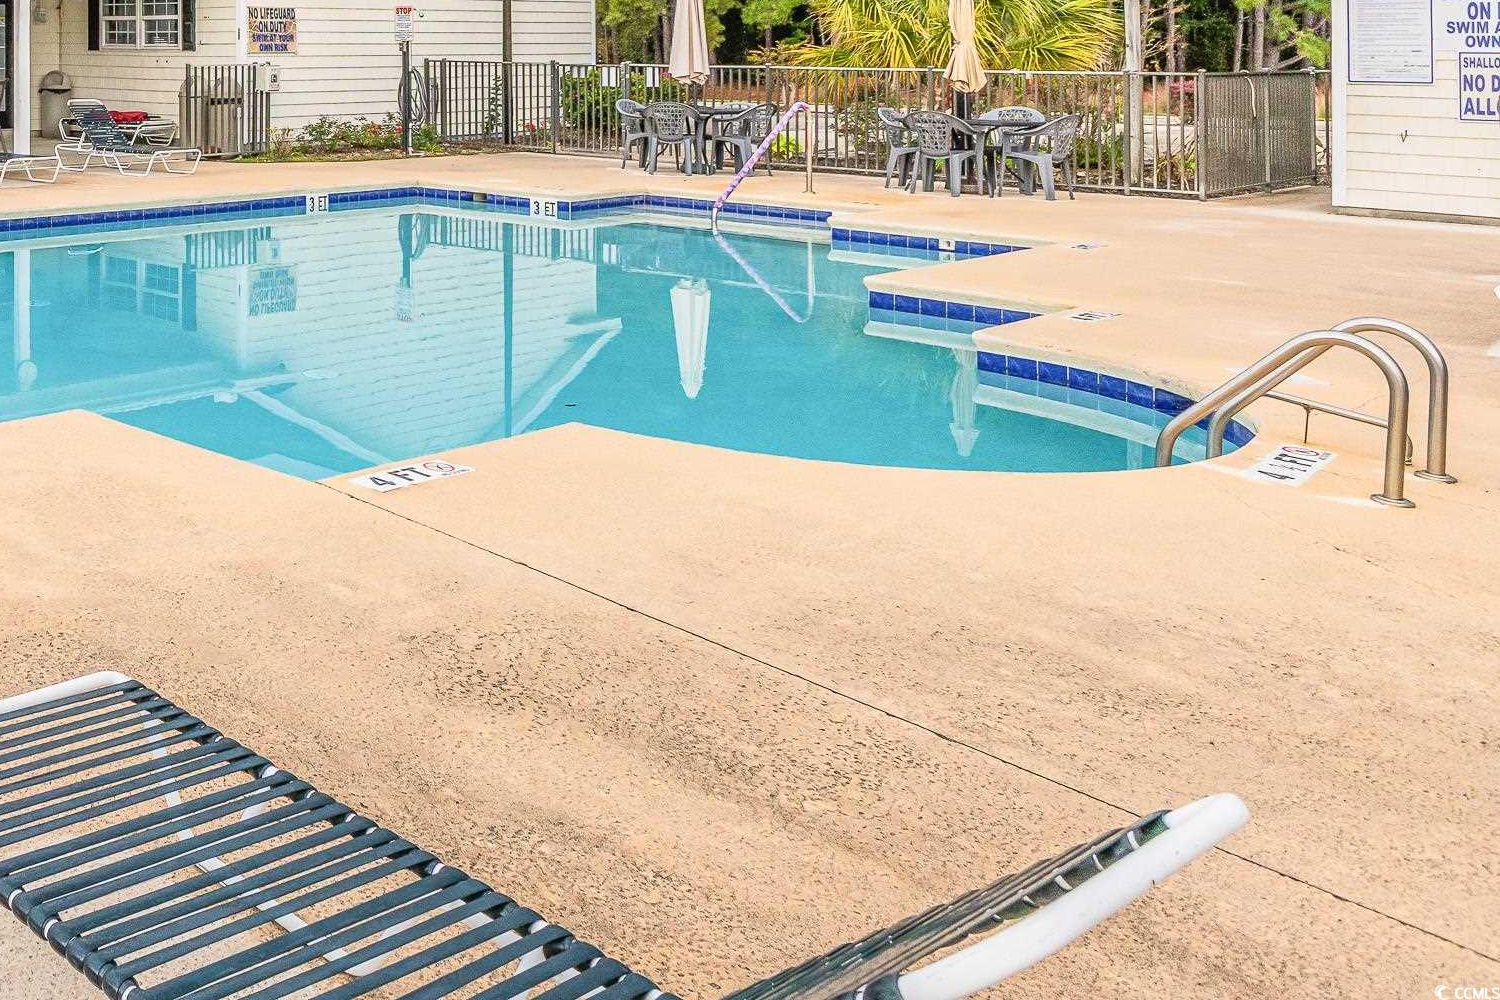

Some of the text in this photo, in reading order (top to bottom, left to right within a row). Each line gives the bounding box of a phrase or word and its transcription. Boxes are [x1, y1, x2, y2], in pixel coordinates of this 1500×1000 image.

[248, 7, 296, 20] NO LIFEGUARD
[395, 7, 412, 15] STOP
[1467, 1, 1491, 20] ON
[259, 20, 288, 32] ON DUTY
[1446, 21, 1489, 34] SWIM
[275, 43, 288, 51] RISK
[1465, 35, 1500, 48] OWN
[1463, 74, 1485, 92] NO
[369, 476, 397, 487] 4
[388, 467, 432, 482] FT
